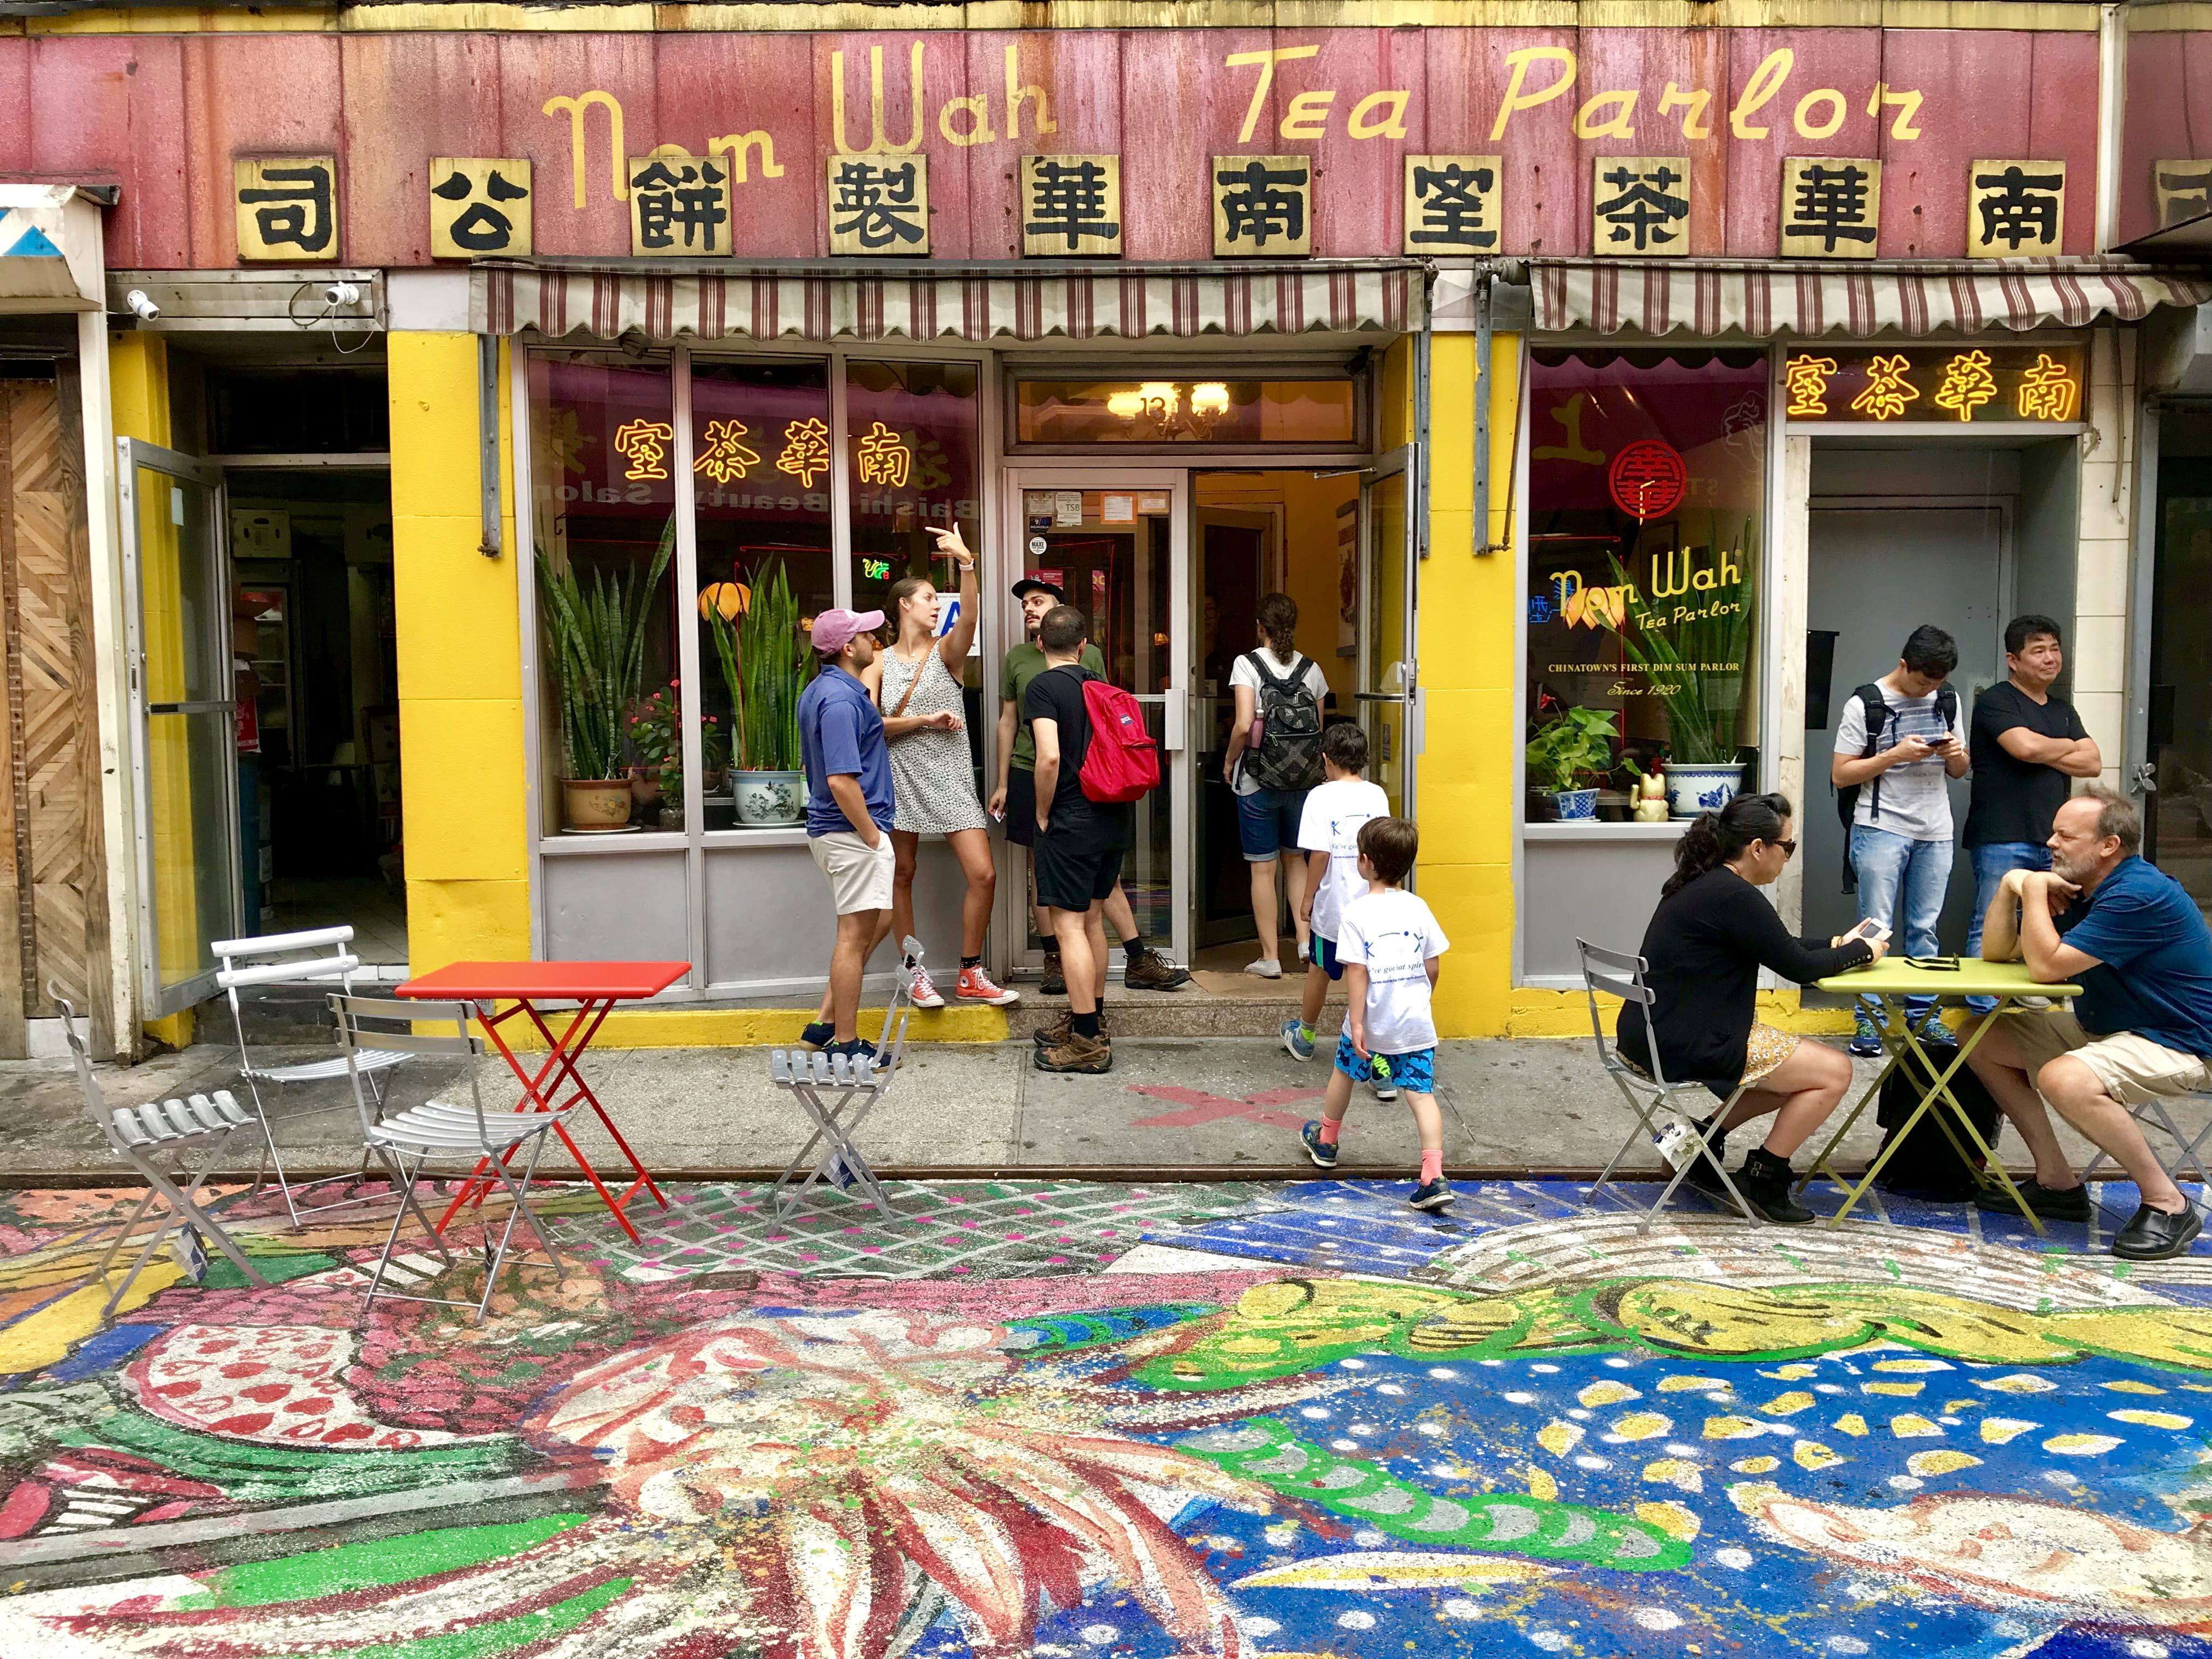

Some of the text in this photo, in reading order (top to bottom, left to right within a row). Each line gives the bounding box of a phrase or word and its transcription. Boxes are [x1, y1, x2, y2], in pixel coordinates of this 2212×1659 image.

[832, 40, 1057, 155] Wah
[1225, 44, 1412, 144] Tea
[1489, 47, 1924, 141] Parlor
[1549, 570, 1638, 617] Nom
[1652, 546, 1741, 597] Wah
[1635, 600, 1741, 630] Tea Parlor
[1548, 664, 1617, 673] CHINATOWN'S
[1621, 664, 1650, 672] FIRST
[1675, 663, 1696, 672] SUM
[1607, 681, 1681, 696] Since 1920
